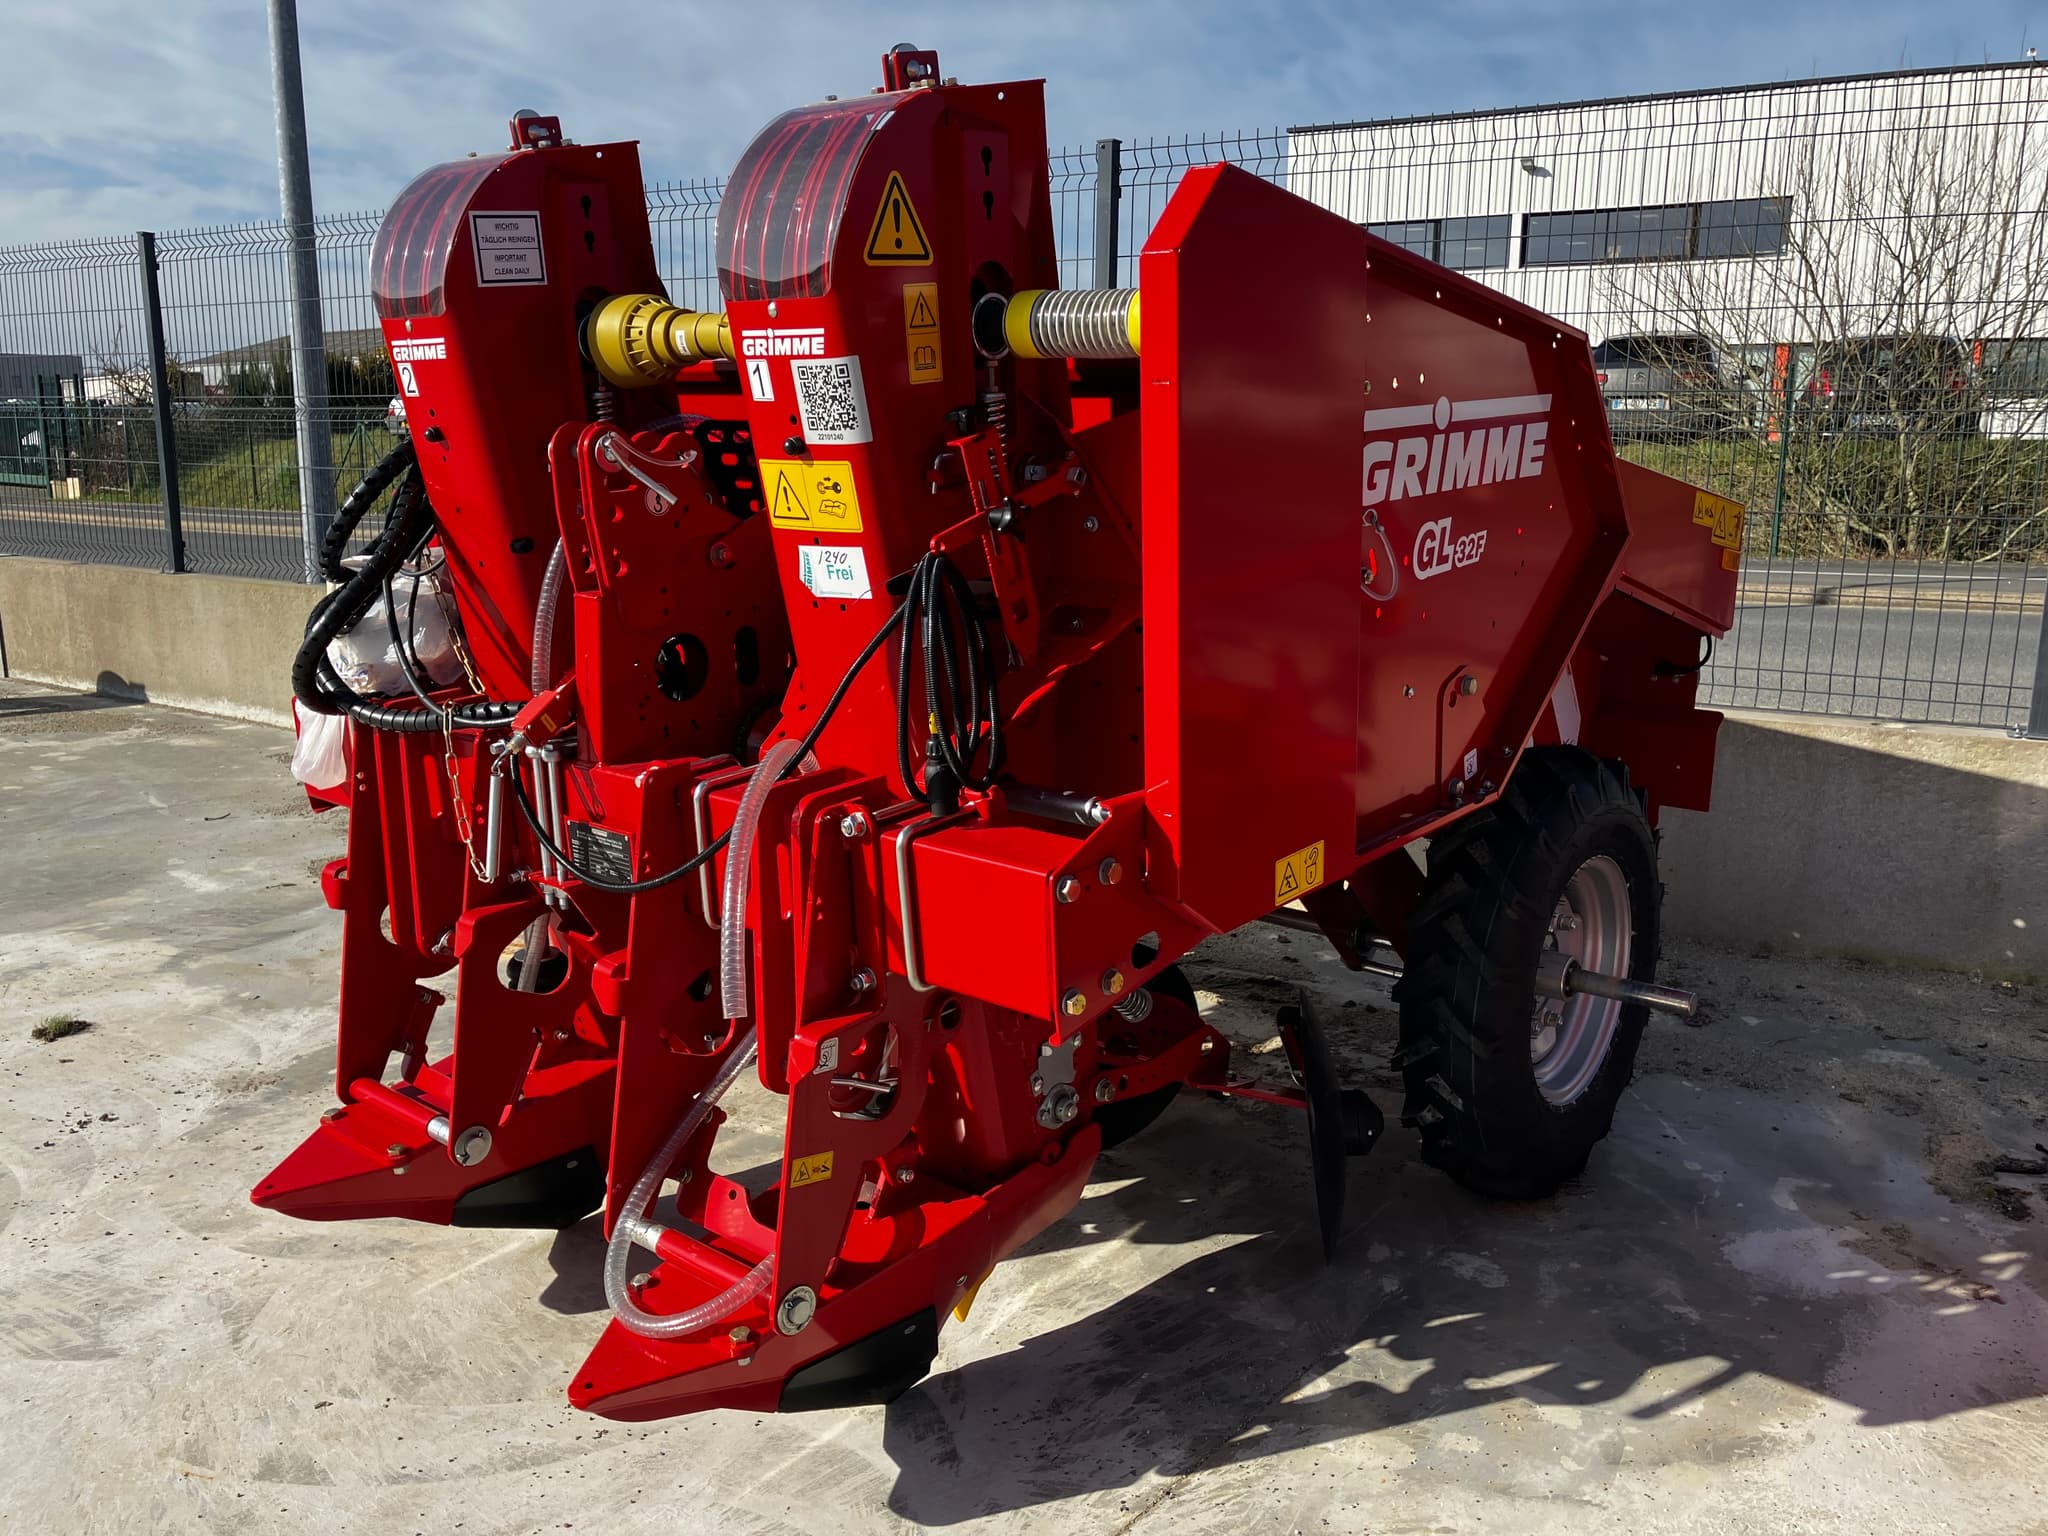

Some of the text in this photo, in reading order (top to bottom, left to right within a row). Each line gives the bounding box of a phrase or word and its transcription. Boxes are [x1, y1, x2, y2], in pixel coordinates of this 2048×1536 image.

[494, 223, 519, 231] WICHTIG
[481, 235, 506, 243] TÄGLICH
[494, 254, 527, 262] IMPORTANT
[391, 338, 447, 361] GRIMME
[742, 328, 825, 356] GRIMME
[402, 367, 417, 393] 2
[752, 363, 765, 397] 1
[1362, 396, 1549, 507] GRIMME
[818, 551, 848, 565] 1240
[826, 564, 854, 581] Frei
